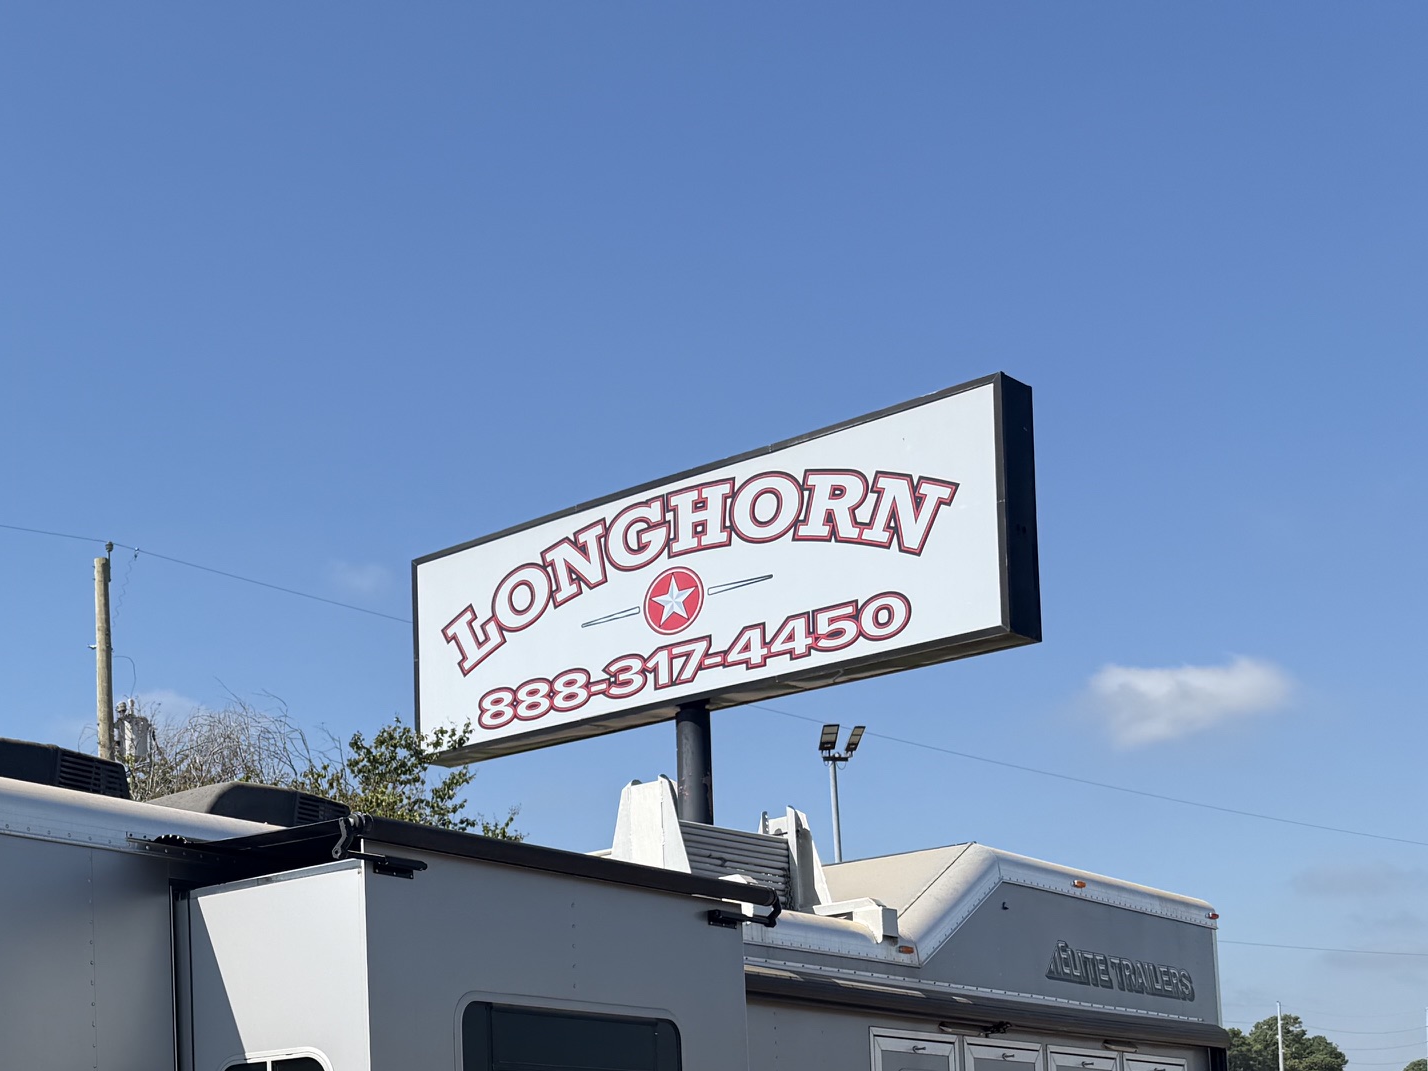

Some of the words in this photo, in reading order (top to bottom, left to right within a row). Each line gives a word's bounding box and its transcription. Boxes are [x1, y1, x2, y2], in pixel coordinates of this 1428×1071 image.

[442, 469, 960, 676] LONGHORN
[478, 591, 911, 729] 888-317-4450
[1045, 940, 1113, 989] ELITE
[1108, 955, 1195, 1001] TRAILERS
